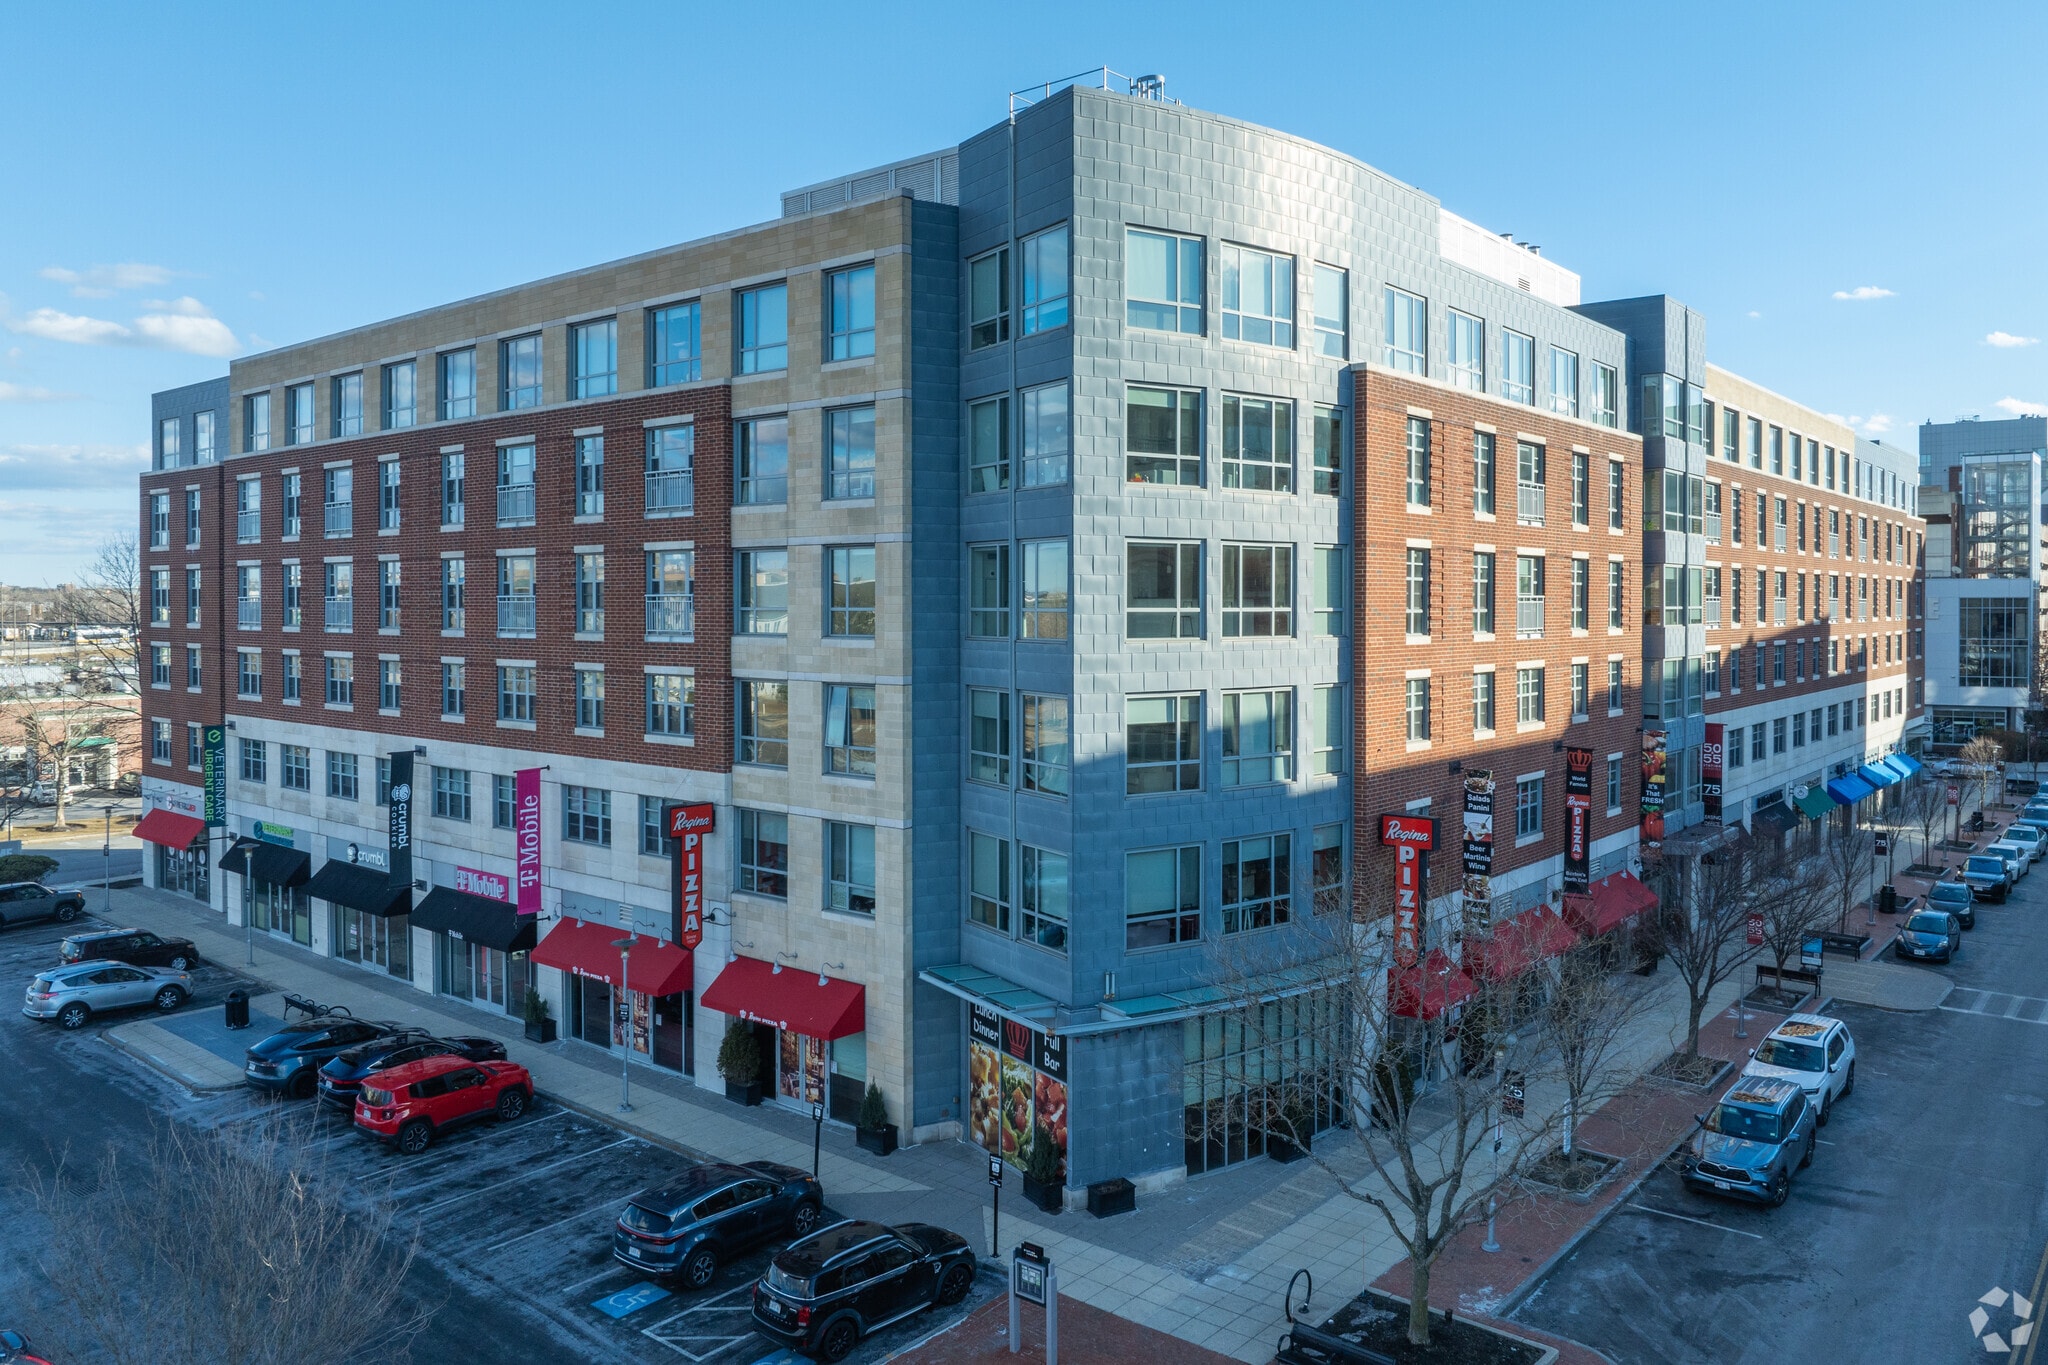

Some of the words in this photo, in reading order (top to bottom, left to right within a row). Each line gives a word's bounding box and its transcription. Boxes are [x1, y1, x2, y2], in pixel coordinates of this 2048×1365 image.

[205, 749, 214, 792] URGENT
[215, 747, 225, 821] VETERINARY
[1703, 784, 1721, 795] 75
[206, 795, 214, 821] CARE
[1467, 793, 1491, 803] Salads
[1467, 802, 1490, 812] Panini
[1641, 796, 1664, 804] FRESH
[398, 803, 409, 849] crumbl
[673, 811, 711, 831] Regina
[1385, 820, 1430, 842] Regina
[1573, 807, 1582, 852] PIZZA
[357, 850, 385, 867] crumbl
[1463, 852, 1491, 862] Martinis
[1469, 844, 1486, 853] Beer
[1468, 862, 1486, 870] Wine
[684, 833, 699, 932] PIZZA
[1399, 845, 1415, 950] PIZZA
[973, 1018, 999, 1041] Dinner
[1044, 1032, 1060, 1052] Full
[1044, 1051, 1060, 1072] Bar
